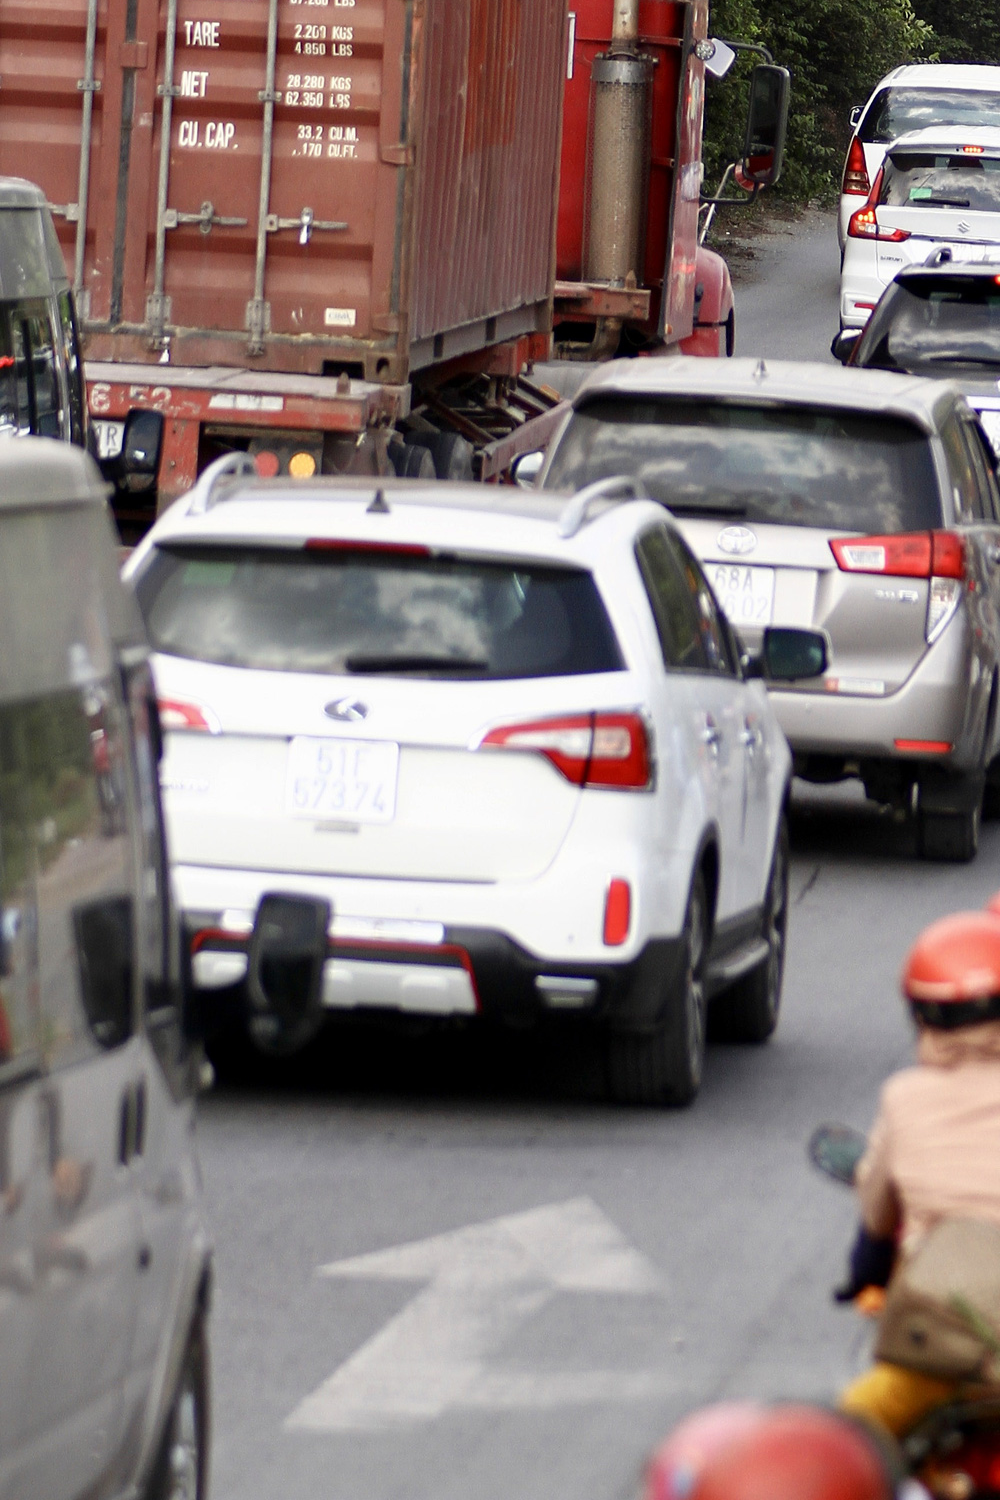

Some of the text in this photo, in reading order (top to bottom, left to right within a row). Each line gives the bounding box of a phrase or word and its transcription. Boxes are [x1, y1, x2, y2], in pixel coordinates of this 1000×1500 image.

[184, 20, 221, 48] TARE
[332, 25, 354, 41] KGS
[294, 42, 354, 57] 4.850 LBS
[180, 70, 352, 98] NET 28.280 KGS
[285, 91, 324, 108] 62.350
[715, 566, 753, 592] 68A
[317, 745, 371, 778] 51F
